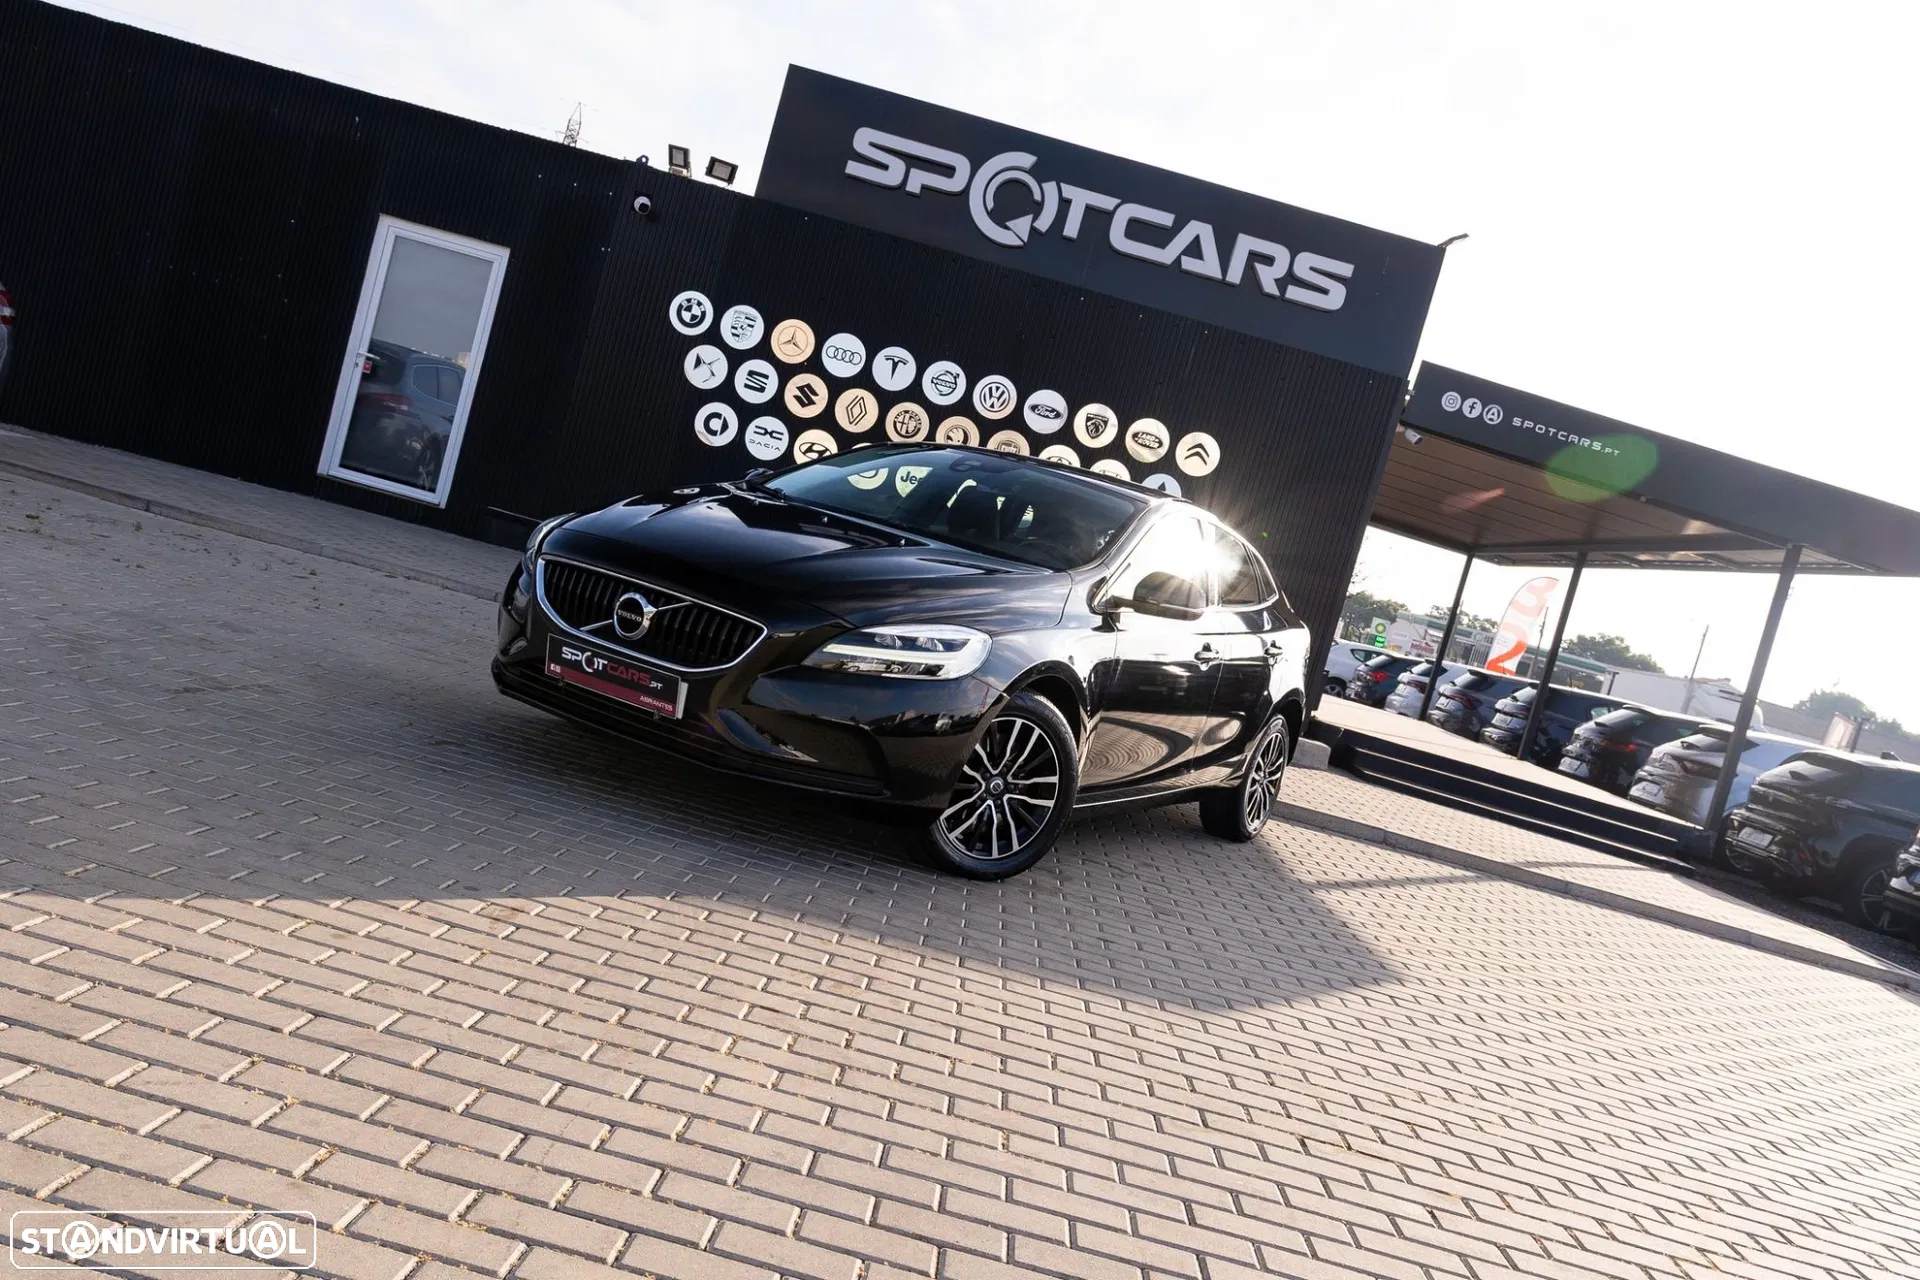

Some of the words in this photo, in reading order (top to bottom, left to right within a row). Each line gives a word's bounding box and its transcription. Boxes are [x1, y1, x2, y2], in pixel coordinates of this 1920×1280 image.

[845, 126, 1355, 312] SPOTCARS
[1034, 403, 1056, 418] Ford
[1137, 431, 1156, 442] LAND
[748, 438, 781, 451] DACIA
[1136, 438, 1160, 449] ROVER
[617, 609, 642, 622] VOLVO
[639, 695, 674, 712] ABRANTES
